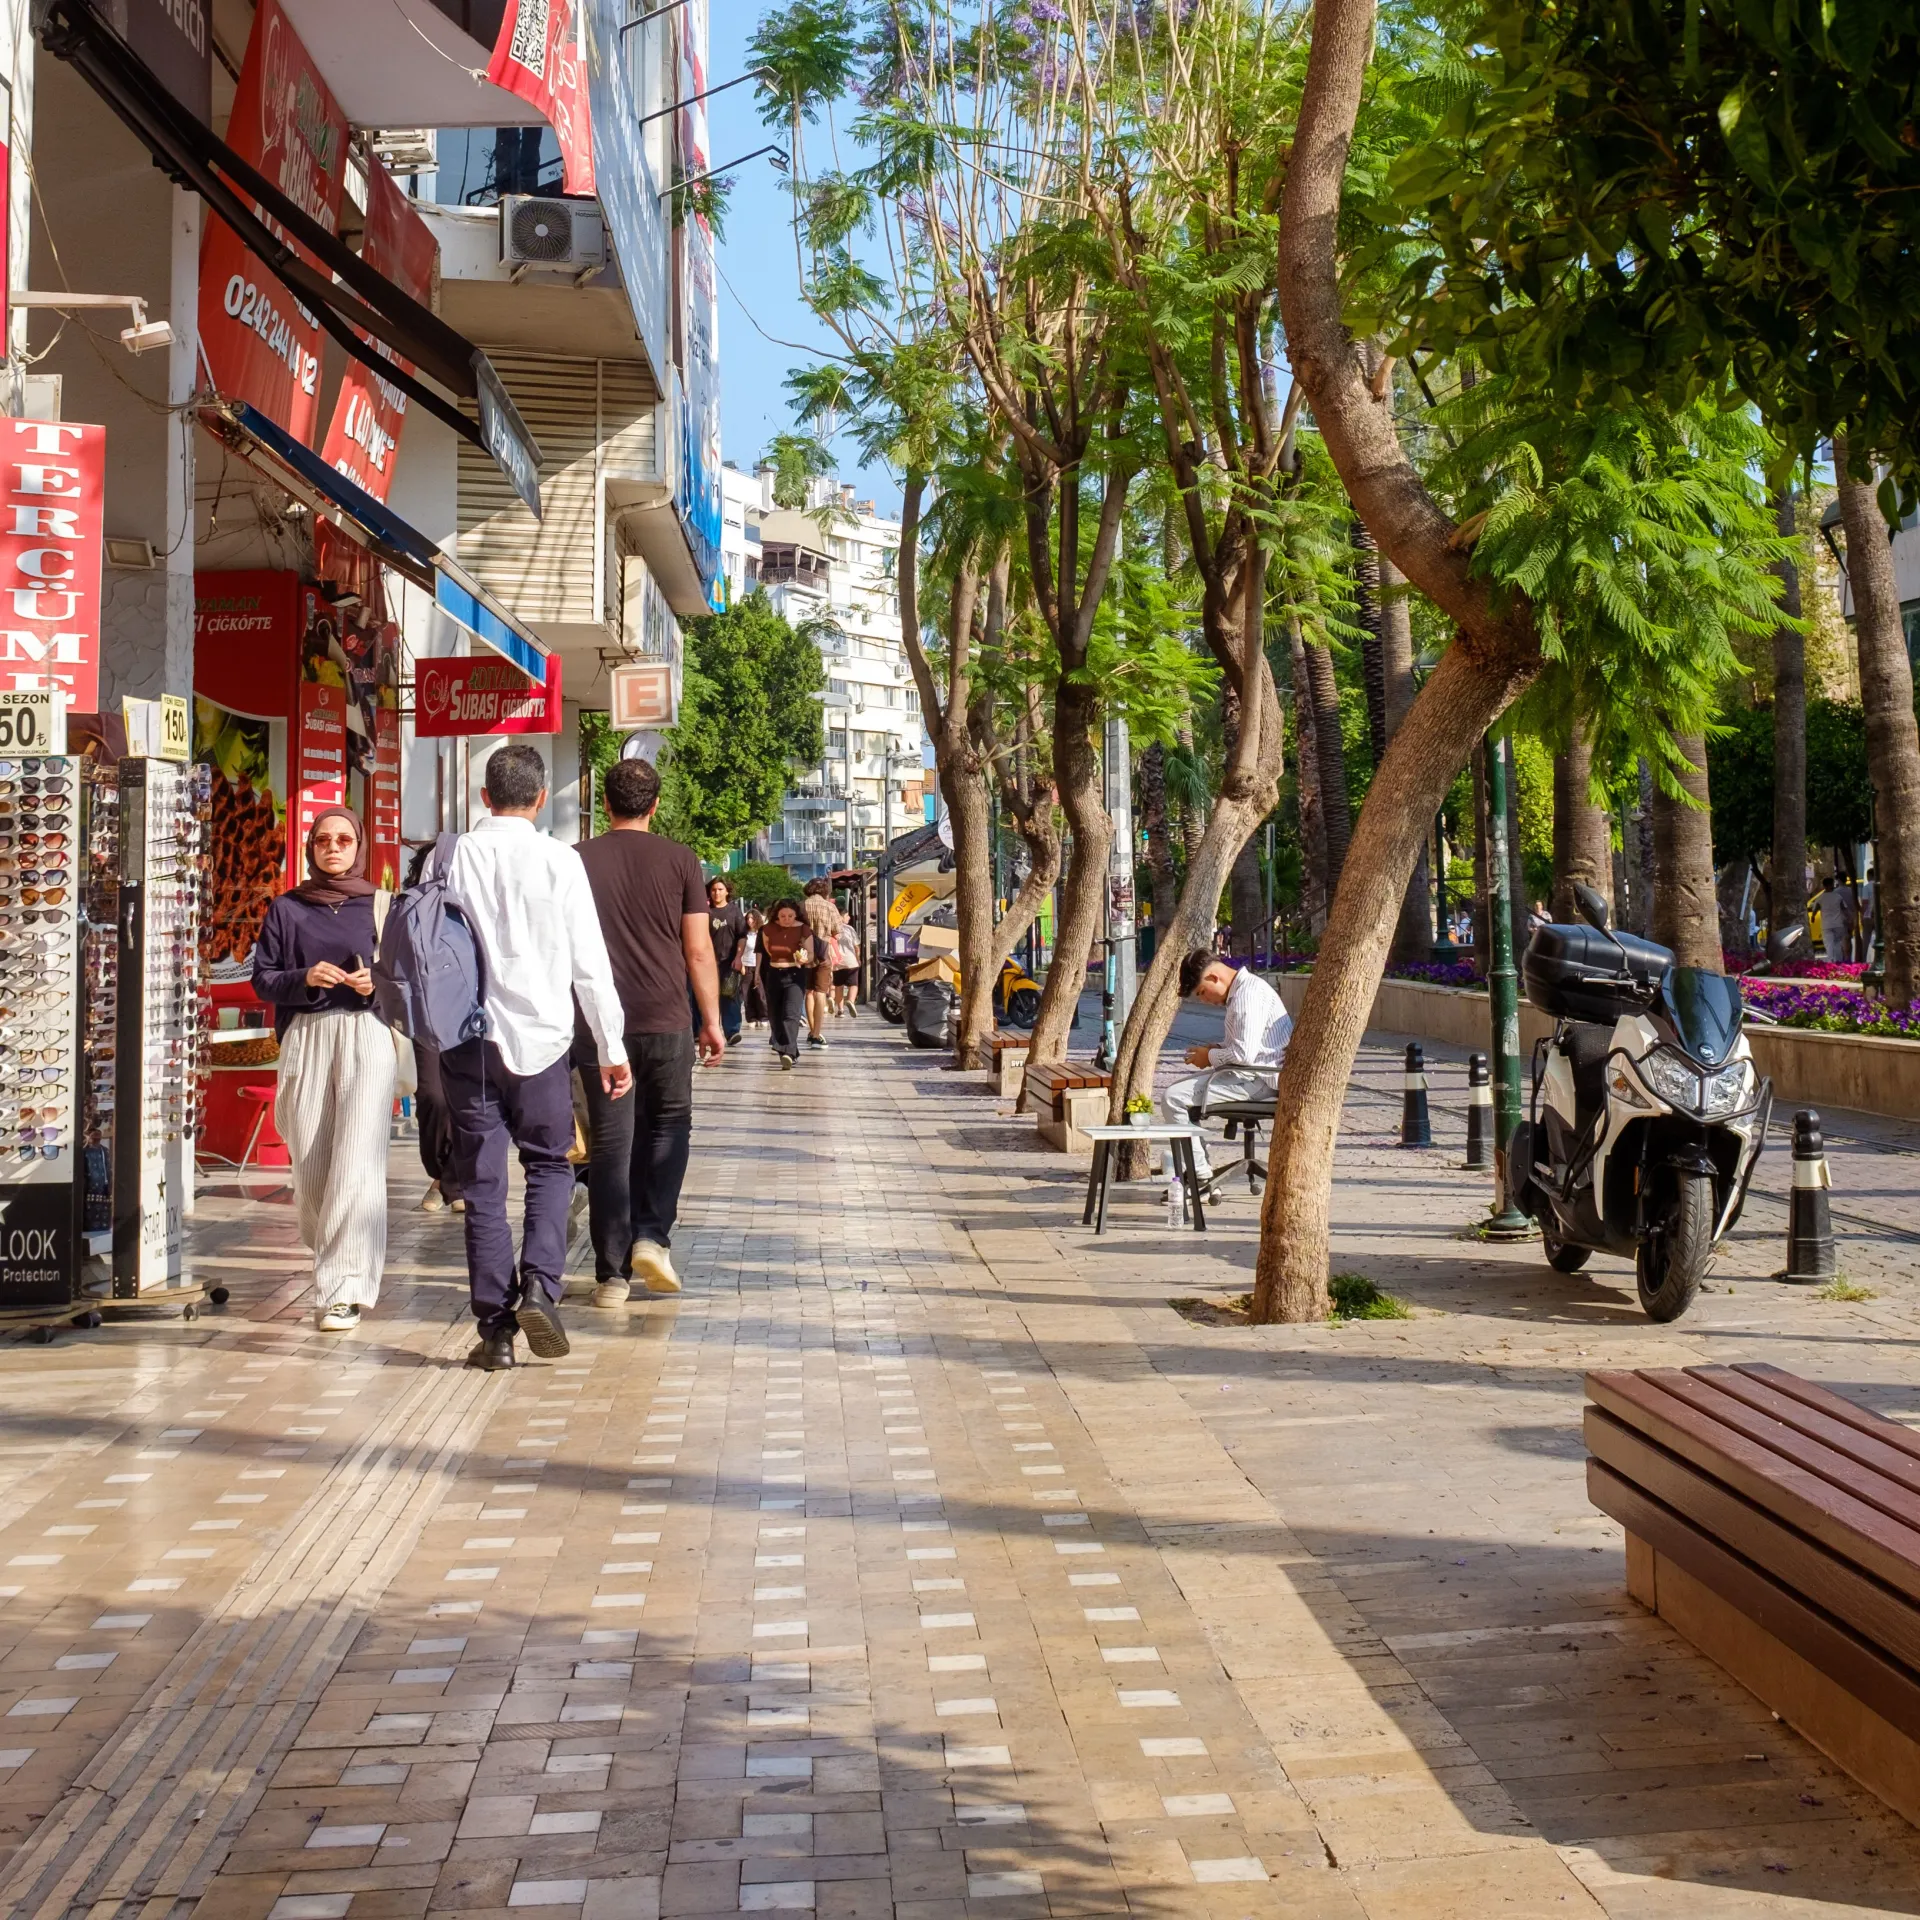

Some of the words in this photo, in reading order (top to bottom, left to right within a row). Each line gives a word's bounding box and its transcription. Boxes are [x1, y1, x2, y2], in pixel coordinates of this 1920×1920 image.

[224, 274, 271, 340] 0242
[268, 310, 291, 362] 244
[302, 351, 318, 396] 02
[3, 694, 50, 705] SEZON
[627, 677, 661, 718] E
[895, 890, 915, 915] getir
[3, 1268, 60, 1282] Protection
